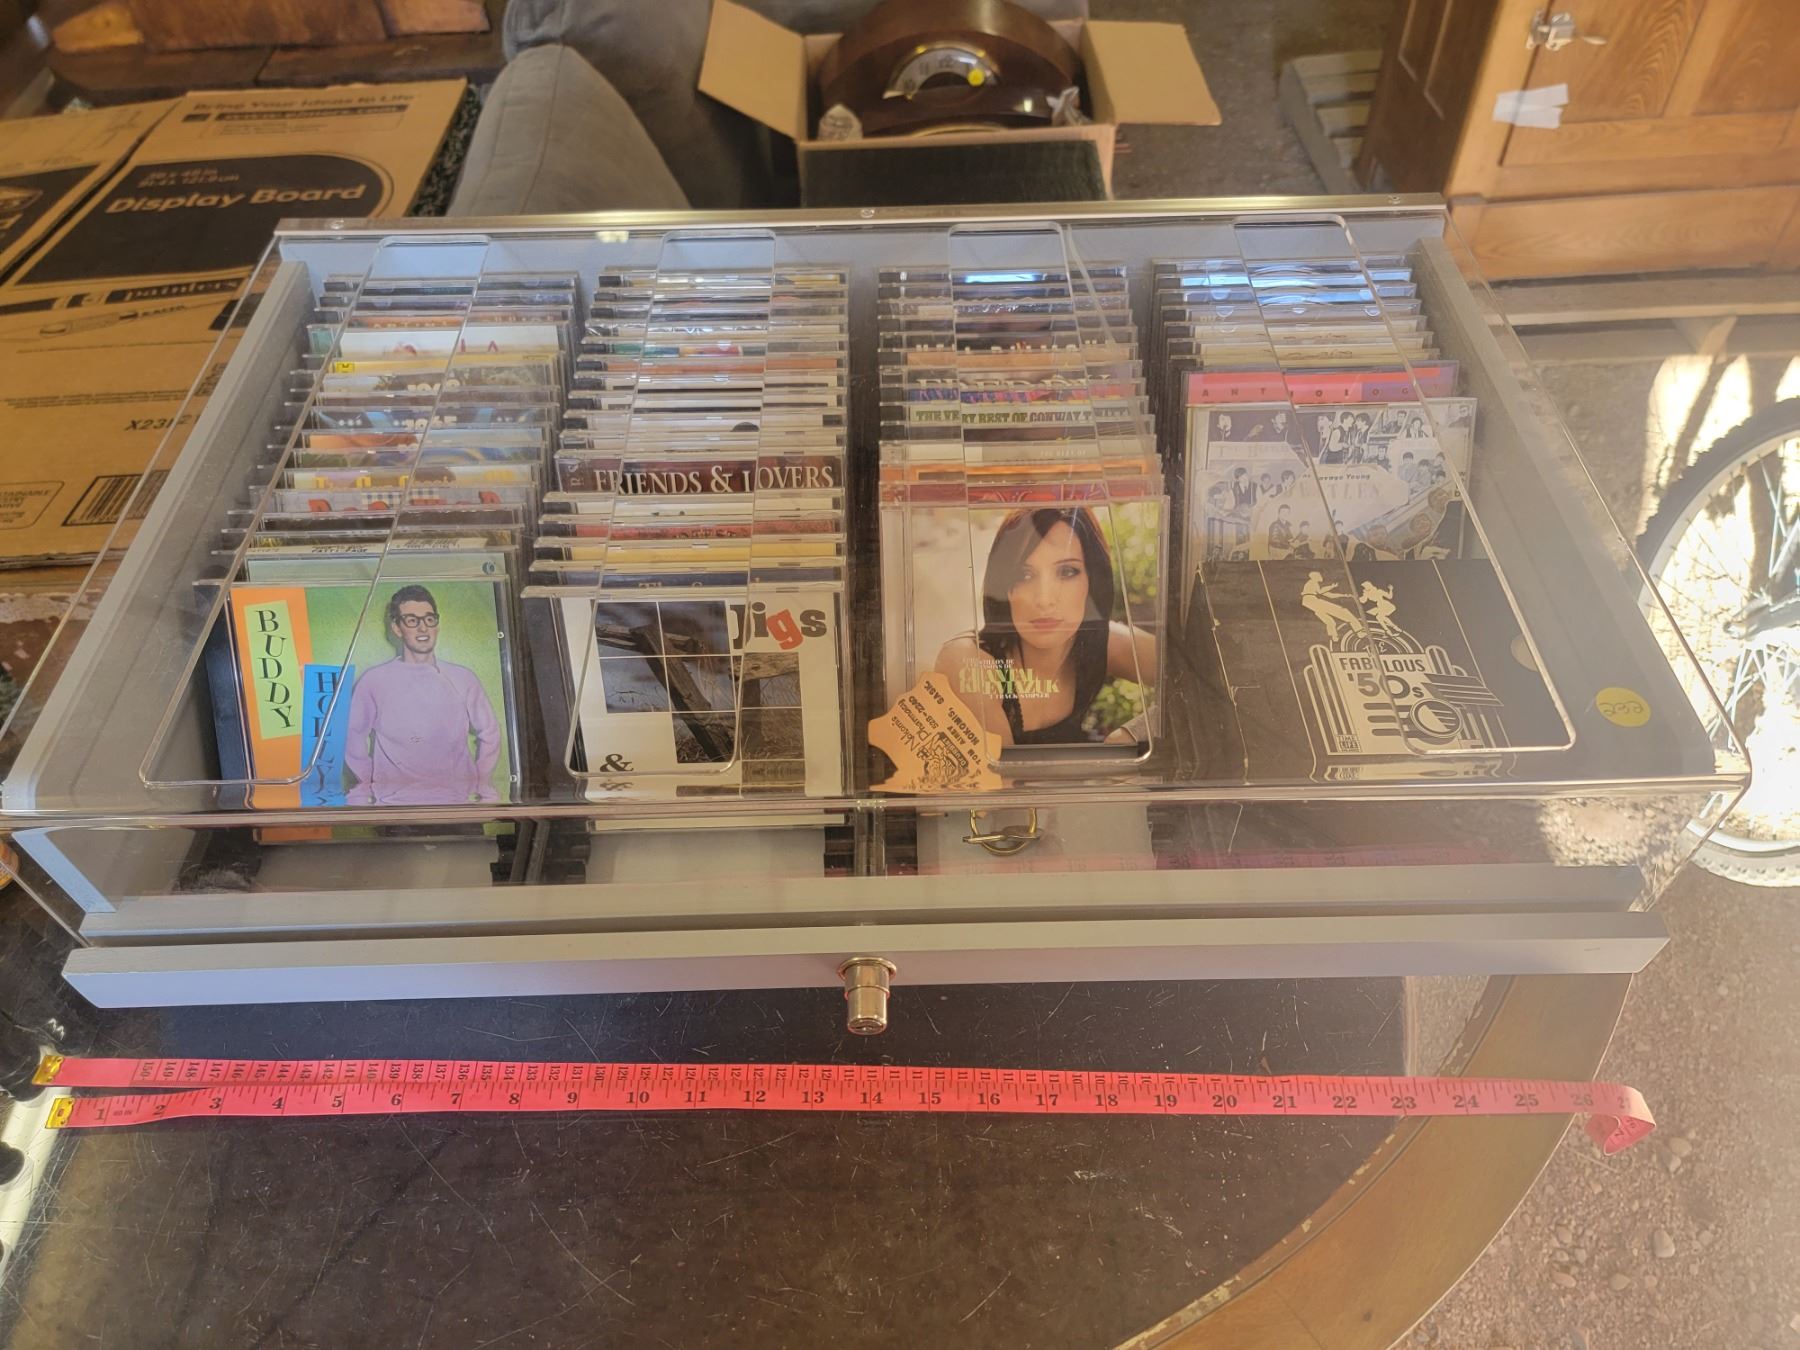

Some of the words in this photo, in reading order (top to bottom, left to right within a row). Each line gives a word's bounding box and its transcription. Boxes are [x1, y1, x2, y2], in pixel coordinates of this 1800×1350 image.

[105, 192, 246, 214] Display
[249, 184, 367, 204] Board
[916, 410, 942, 422] THE
[979, 412, 1010, 424] BEST
[1012, 411, 1028, 424] OF
[593, 468, 702, 495] FRIENDS
[710, 464, 734, 493] &
[743, 465, 834, 493] LOVERS
[730, 602, 828, 650] Jigs
[254, 609, 296, 729] BUDDY
[891, 715, 921, 752] Nokomis
[898, 698, 932, 742] Pharmacy
[599, 753, 634, 773] &
[967, 748, 982, 765] TOM
[97, 1108, 105, 1120] 1
[153, 1105, 166, 1115] 2
[209, 1098, 222, 1109] 3
[272, 1097, 283, 1109] 4
[332, 1096, 343, 1107] 5
[391, 1094, 402, 1105] 6
[451, 1093, 460, 1104] 7
[509, 1093, 520, 1104] 8
[567, 1092, 577, 1103] 9
[627, 1092, 650, 1103] 10
[686, 1091, 706, 1102] 11
[744, 1091, 766, 1102] 12
[802, 1091, 824, 1103] 13
[860, 1092, 883, 1104] 14
[919, 1093, 941, 1104] 15
[978, 1093, 1000, 1105] 16
[1036, 1094, 1059, 1106] 17
[1095, 1094, 1118, 1106] 18
[1154, 1095, 1177, 1107] 19
[1213, 1095, 1237, 1107] 20
[1273, 1096, 1297, 1108] 21
[1333, 1096, 1357, 1108] 22
[1390, 1096, 1417, 1109] 23
[1452, 1095, 1479, 1108] 24
